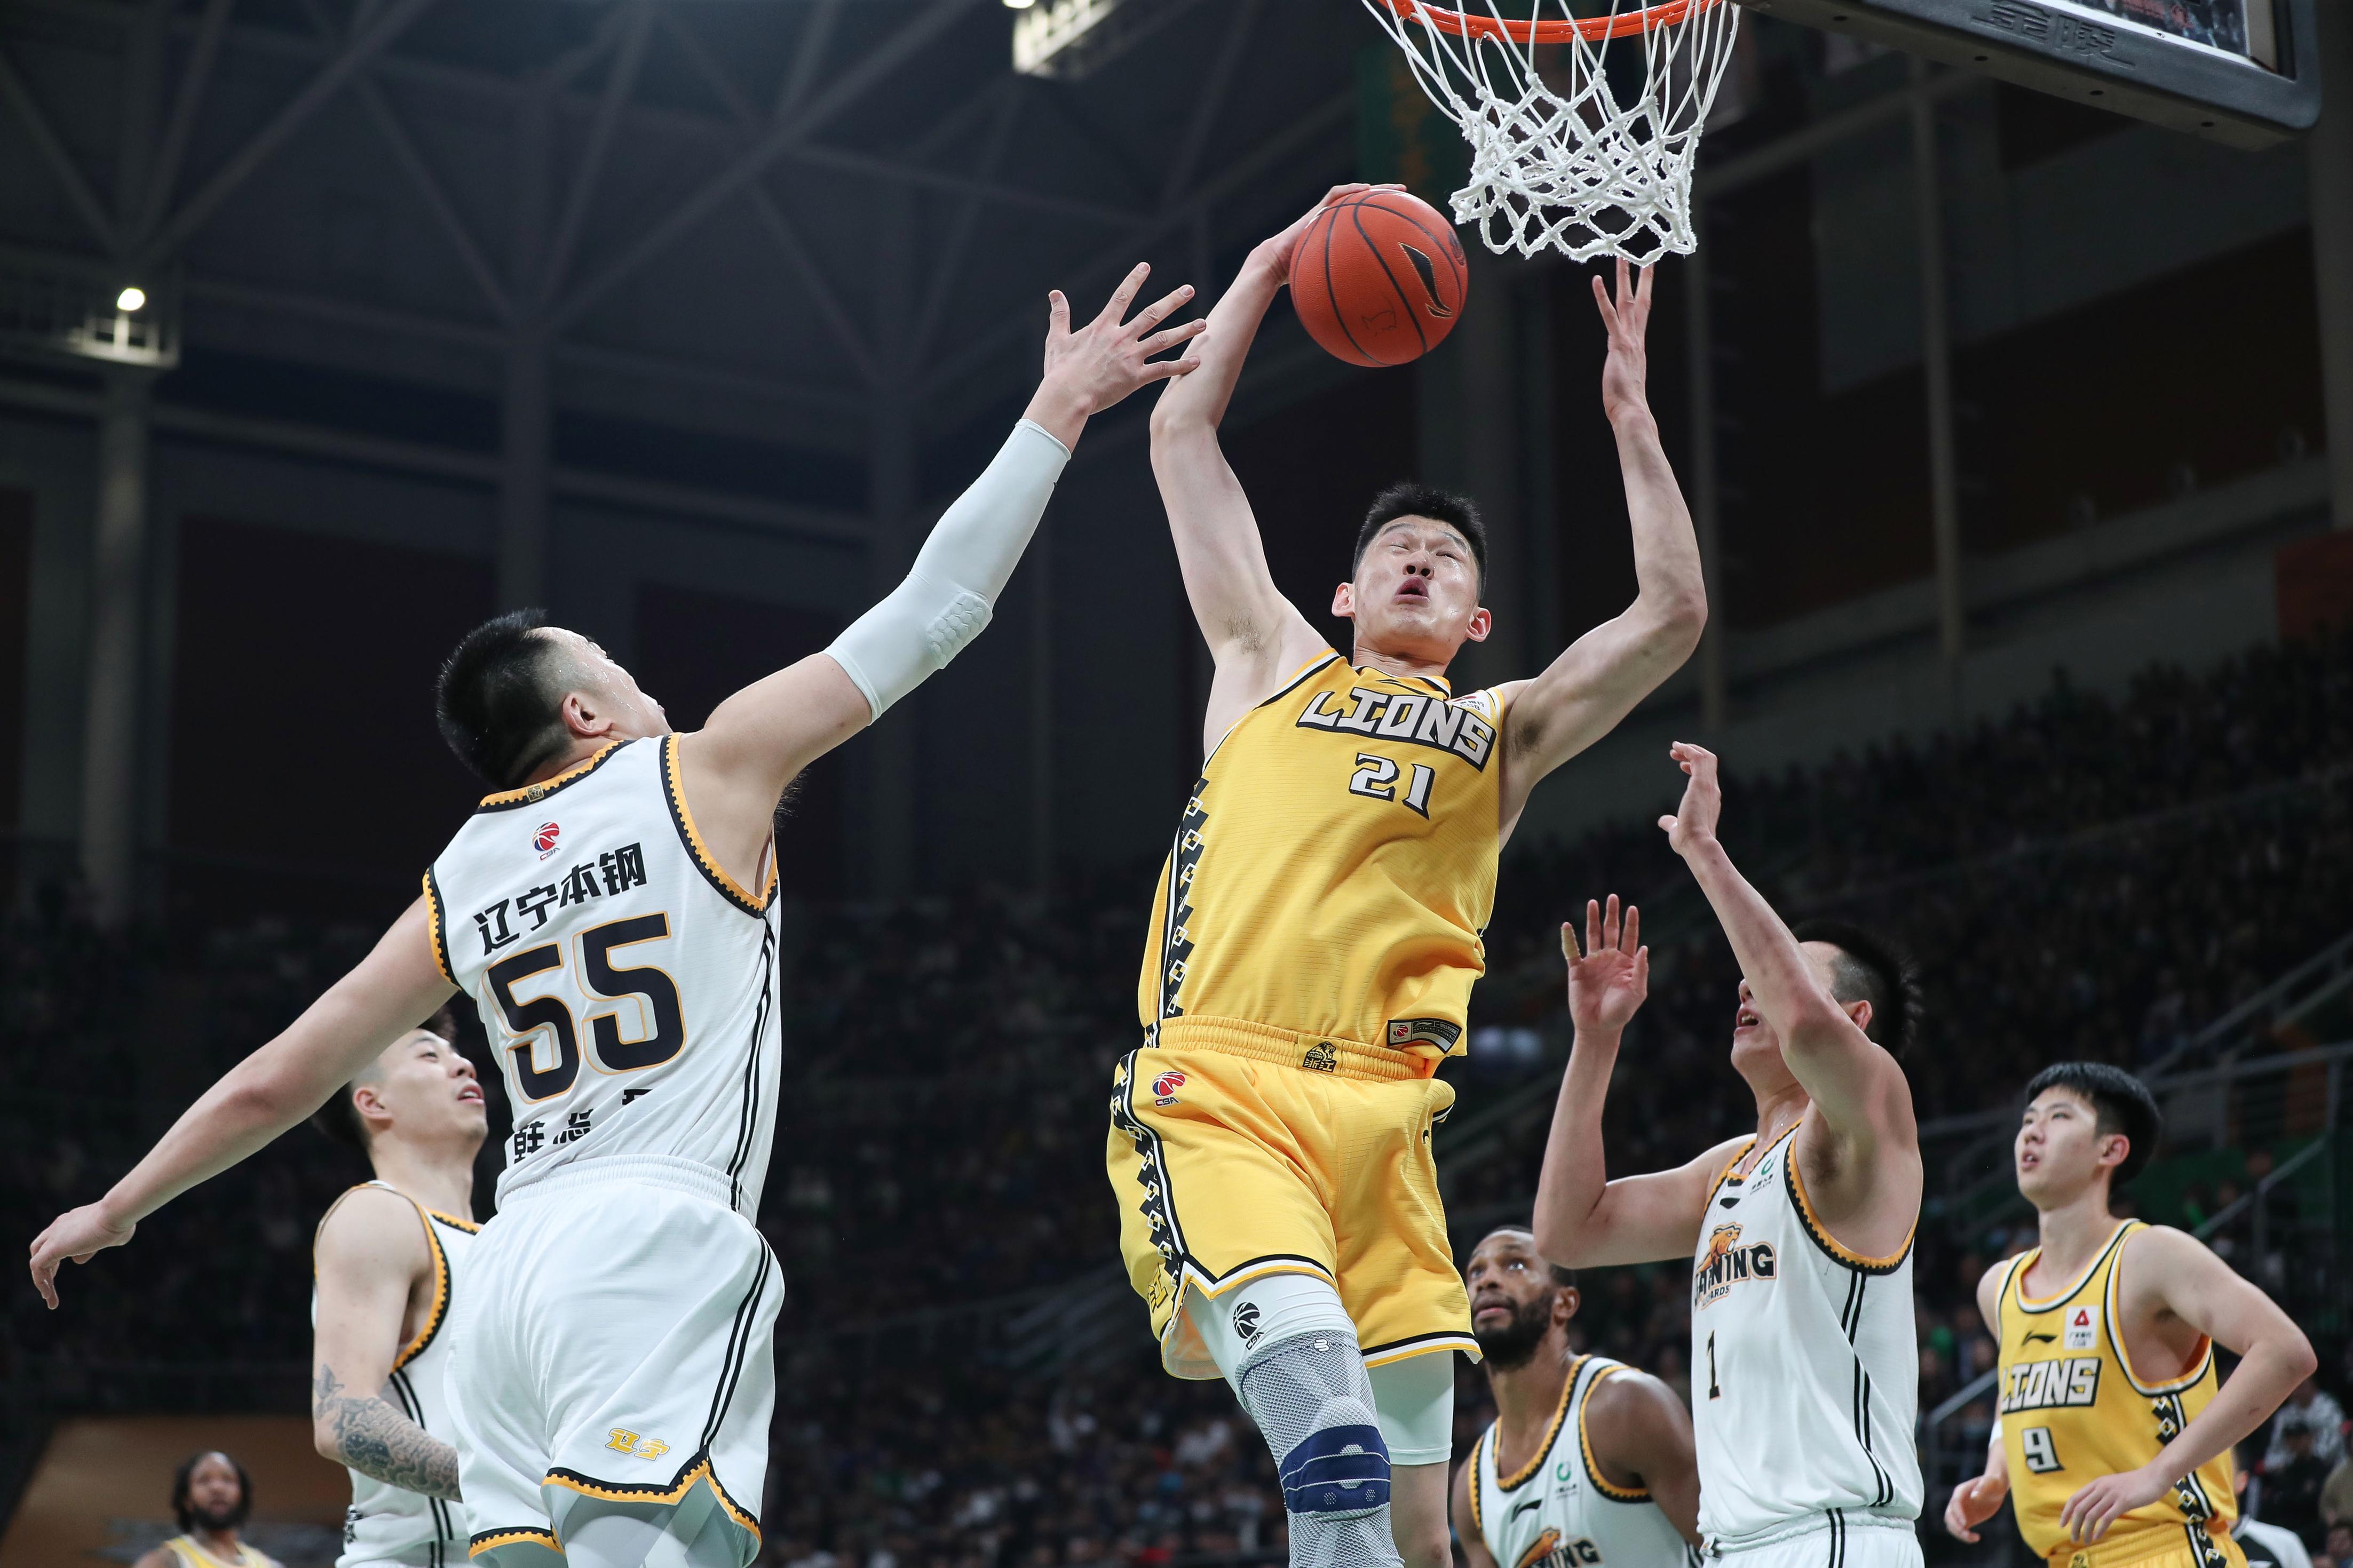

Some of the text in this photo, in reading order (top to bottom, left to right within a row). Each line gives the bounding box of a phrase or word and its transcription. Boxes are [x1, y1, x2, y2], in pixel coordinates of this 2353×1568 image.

[1295, 686, 1497, 773] LIONS
[1349, 752, 1436, 821] 21
[540, 847, 560, 861] CBA
[472, 842, 647, 957] 辽宁本钢
[481, 911, 687, 1105] 55
[1155, 1096, 1180, 1107] CBA
[1246, 1332, 1265, 1350] CBA
[1706, 1329, 1721, 1401] 1
[2000, 1357, 2102, 1415] LIONS
[2022, 1427, 2065, 1474] 9
